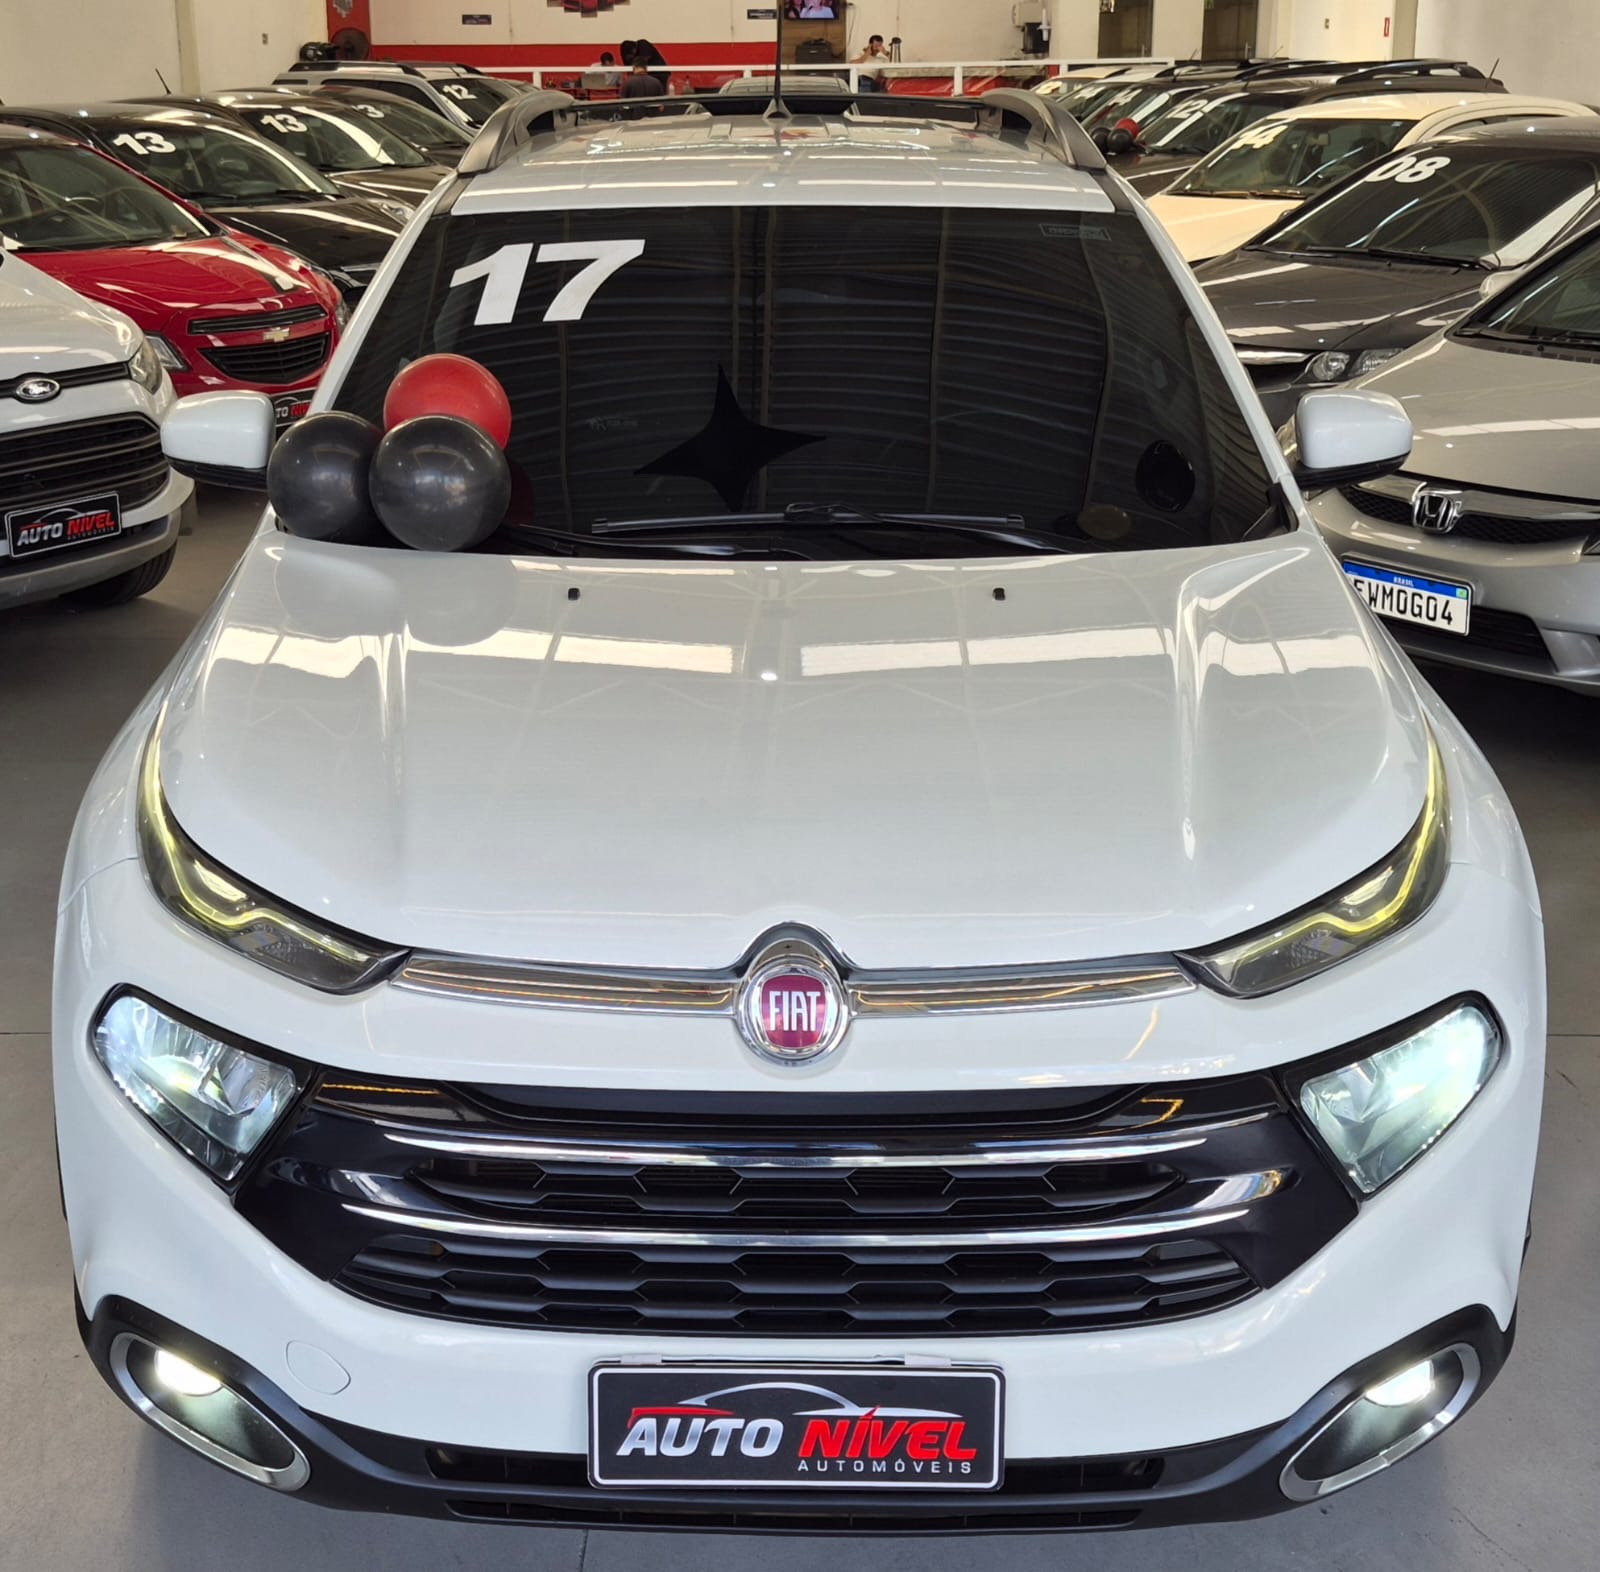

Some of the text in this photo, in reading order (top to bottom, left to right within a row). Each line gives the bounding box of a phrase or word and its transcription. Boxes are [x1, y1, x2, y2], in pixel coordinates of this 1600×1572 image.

[443, 85, 477, 100] 12
[260, 114, 308, 133] 13
[113, 132, 176, 155] 13
[1364, 156, 1451, 183] 08
[449, 239, 646, 326] 17
[17, 522, 63, 546] AUTO
[769, 990, 821, 1031] FIAT
[616, 1405, 977, 1460] AUTO NÍVEL
[798, 1457, 972, 1474] AUTOMÓVEIS
